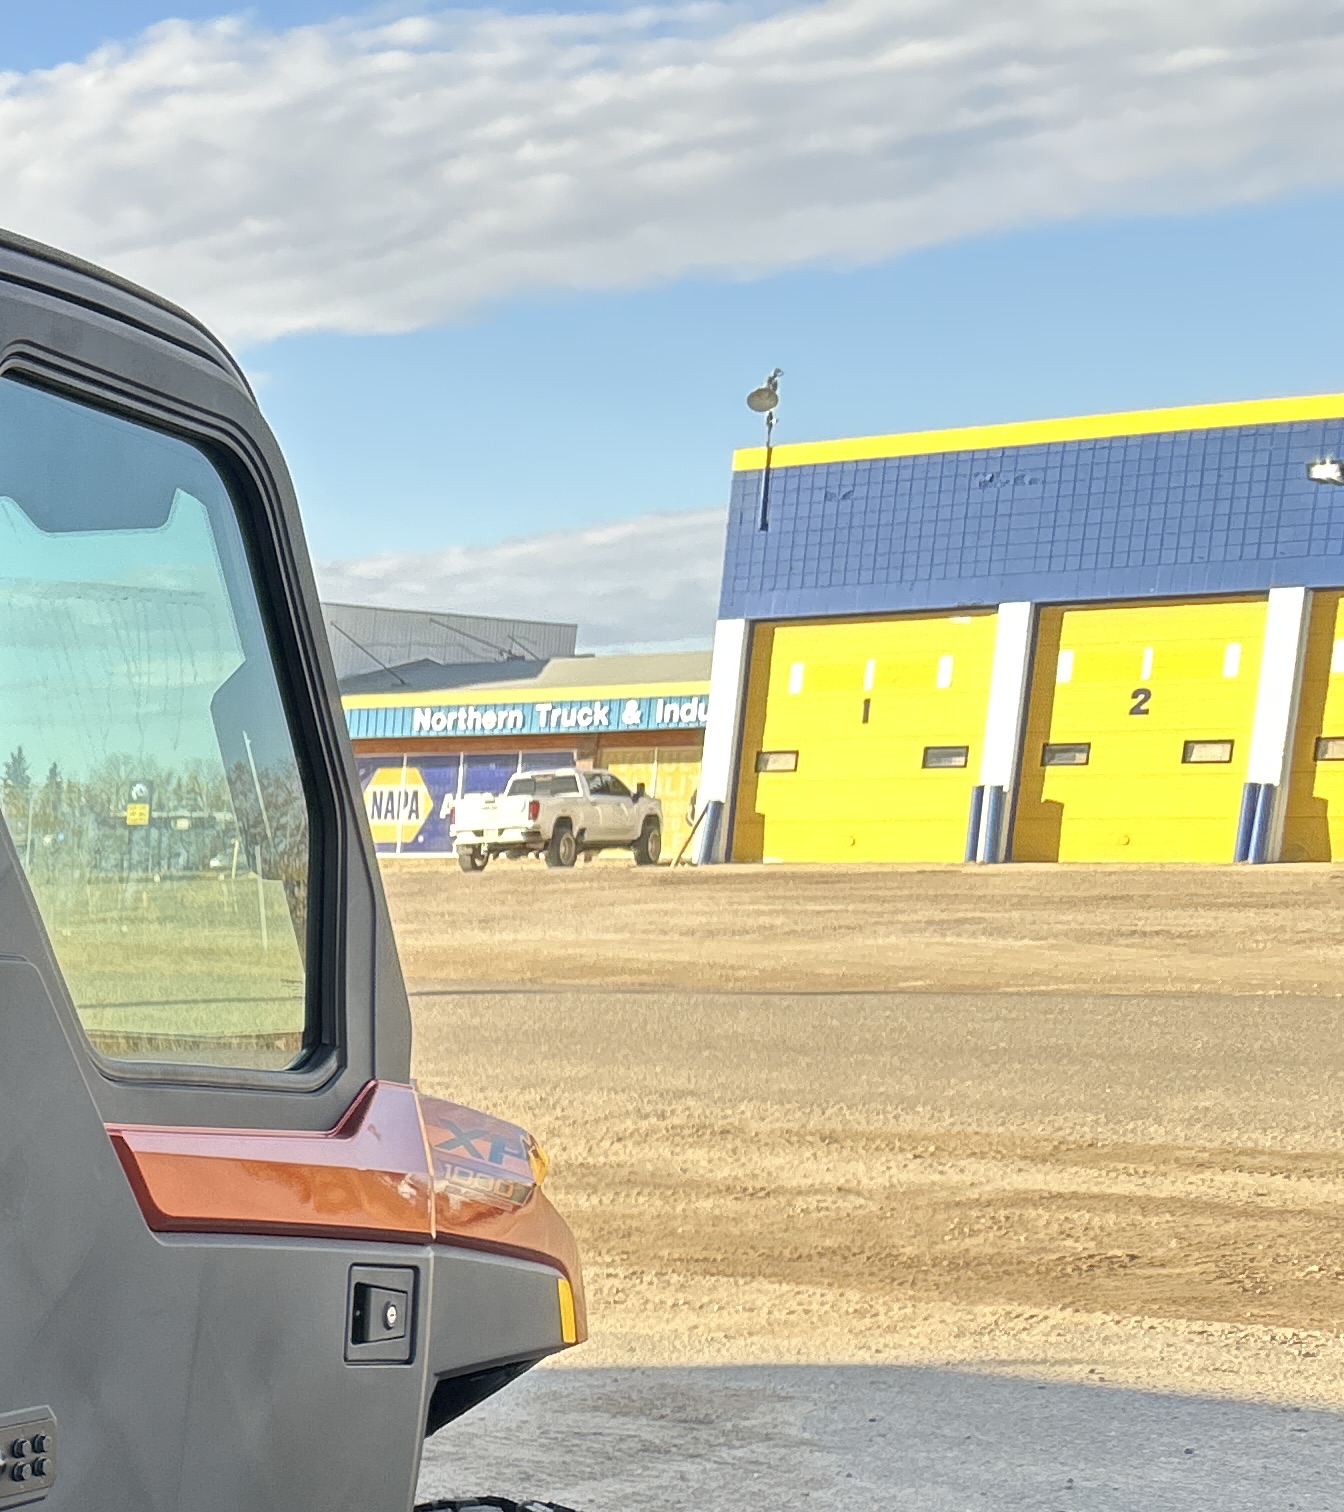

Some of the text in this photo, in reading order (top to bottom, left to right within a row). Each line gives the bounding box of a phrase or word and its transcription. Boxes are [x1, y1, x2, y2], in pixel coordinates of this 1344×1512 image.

[413, 706, 523, 732] Northern
[536, 702, 609, 728] Truck
[621, 700, 641, 725] &
[862, 698, 871, 724] 1
[1129, 688, 1152, 715] 2
[371, 790, 419, 820] NAPA
[434, 1119, 529, 1166] XP
